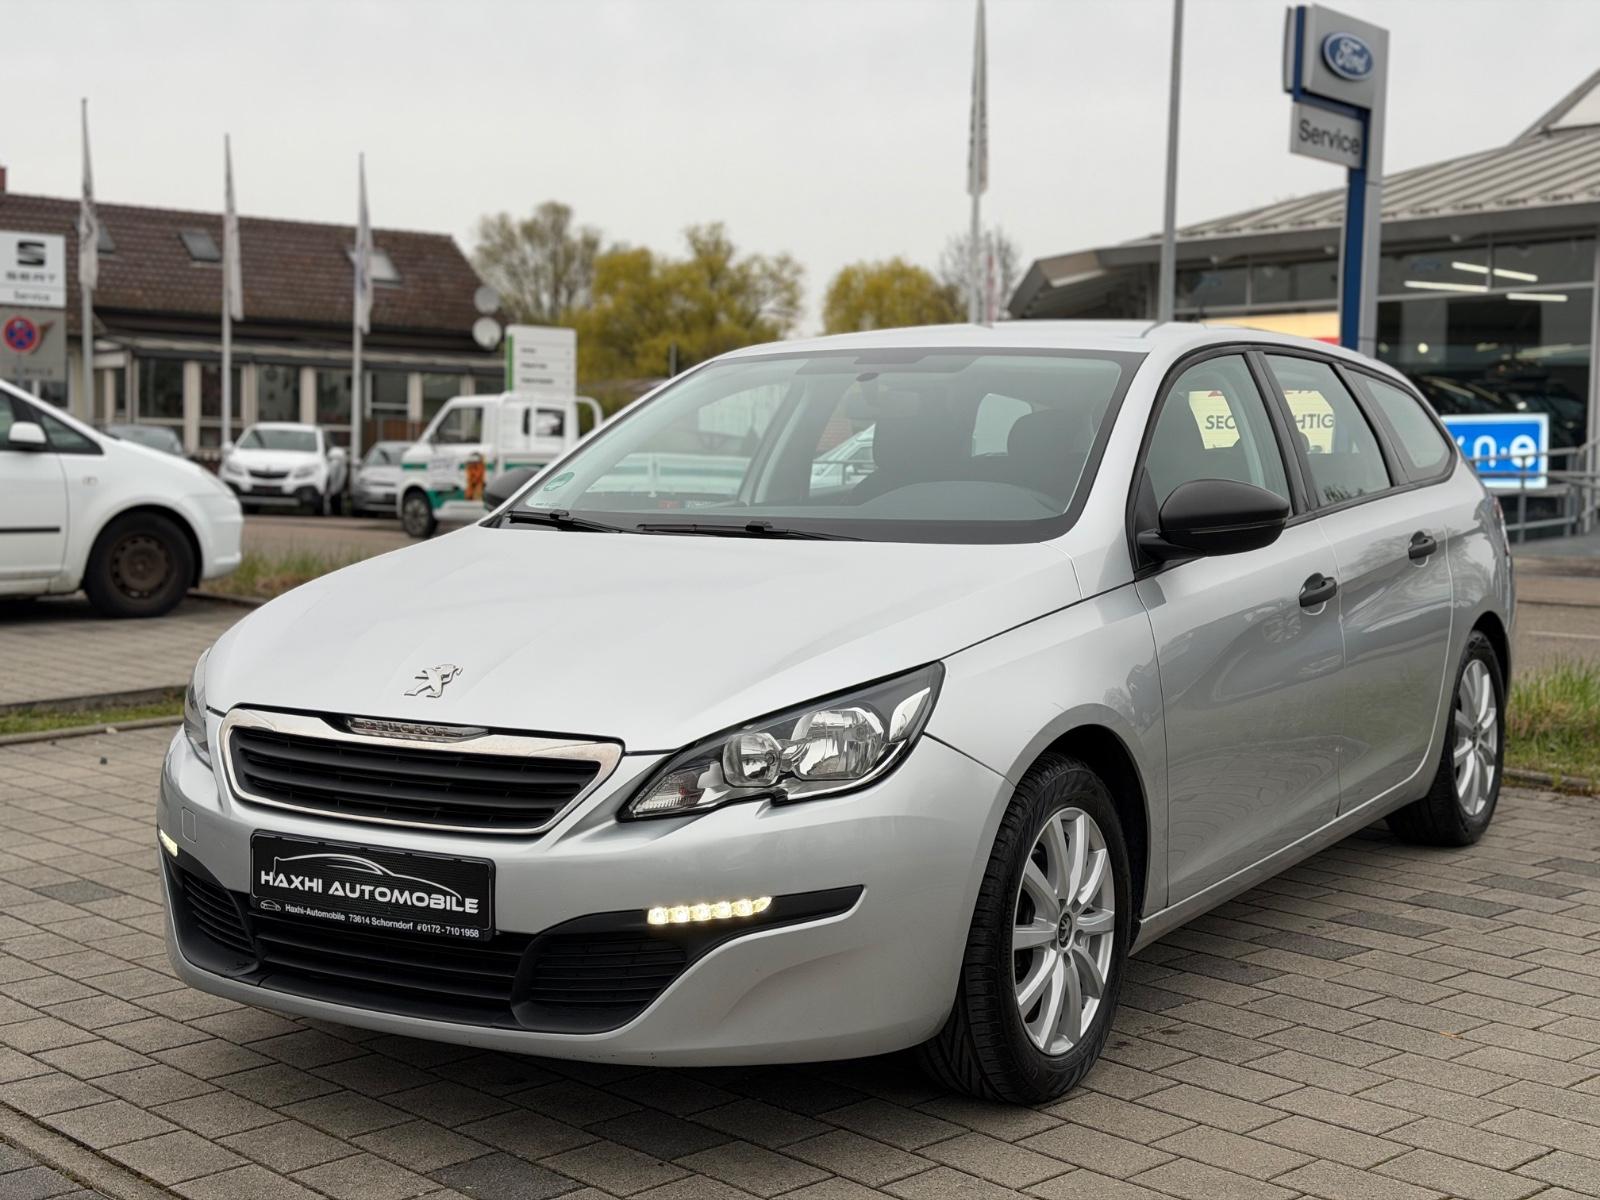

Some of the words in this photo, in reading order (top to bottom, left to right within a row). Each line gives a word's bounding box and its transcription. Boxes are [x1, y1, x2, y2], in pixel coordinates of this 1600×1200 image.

[1299, 119, 1361, 156] Service
[261, 870, 323, 893] HAXHI
[328, 881, 479, 914] AUTOMOBILE
[285, 904, 346, 921] Haxhi-Automobile
[371, 917, 413, 930] Schorndorf
